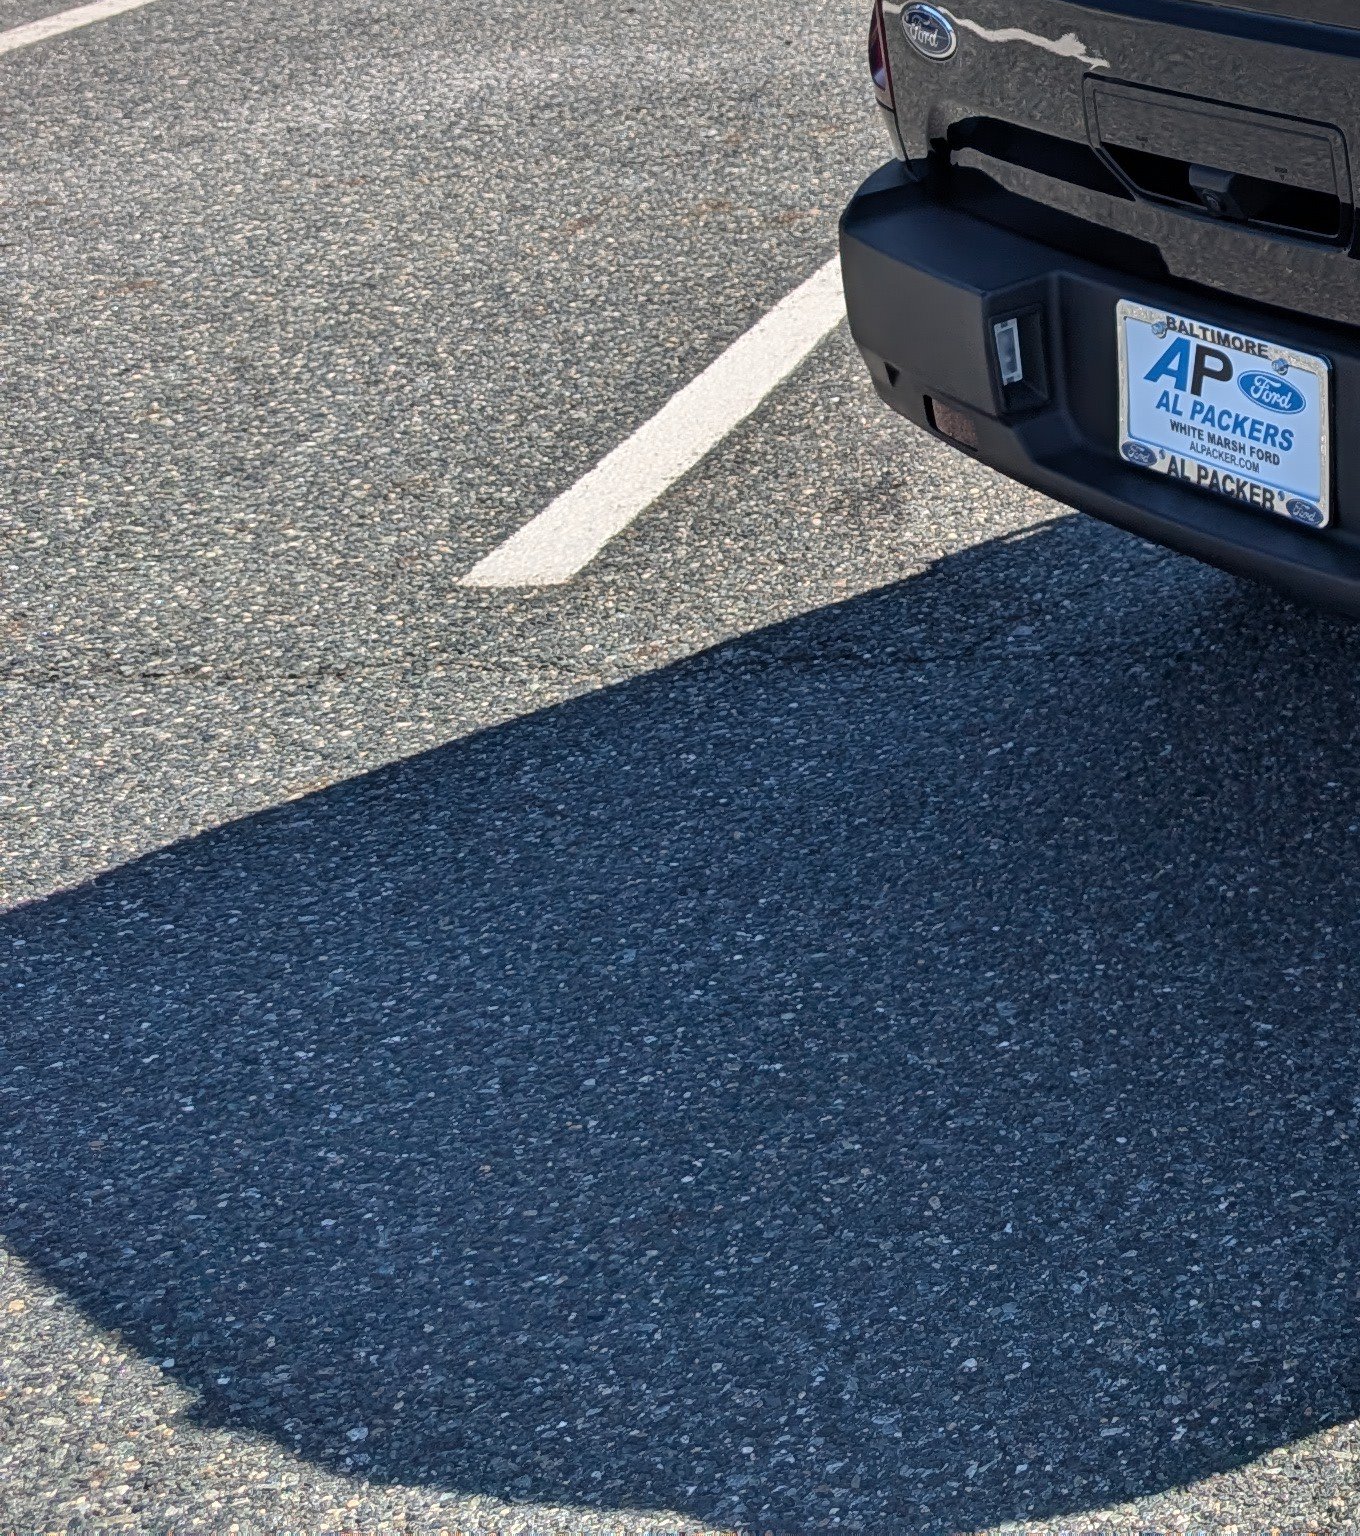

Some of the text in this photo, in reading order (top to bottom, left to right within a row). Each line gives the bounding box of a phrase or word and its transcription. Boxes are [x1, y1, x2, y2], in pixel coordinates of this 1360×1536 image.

[908, 14, 939, 48] Ford
[1165, 315, 1269, 360] BALTIMORE
[1144, 336, 1233, 397] AP
[1250, 371, 1293, 410] Ford
[1156, 390, 1295, 452] AL PACKERS
[1169, 418, 1281, 466] WHITE MARSH FORD
[1125, 441, 1153, 463] Ford
[1189, 440, 1261, 474] ALPACKER.COM
[1167, 454, 1276, 513] AL PACKER
[1291, 500, 1318, 522] Ford
